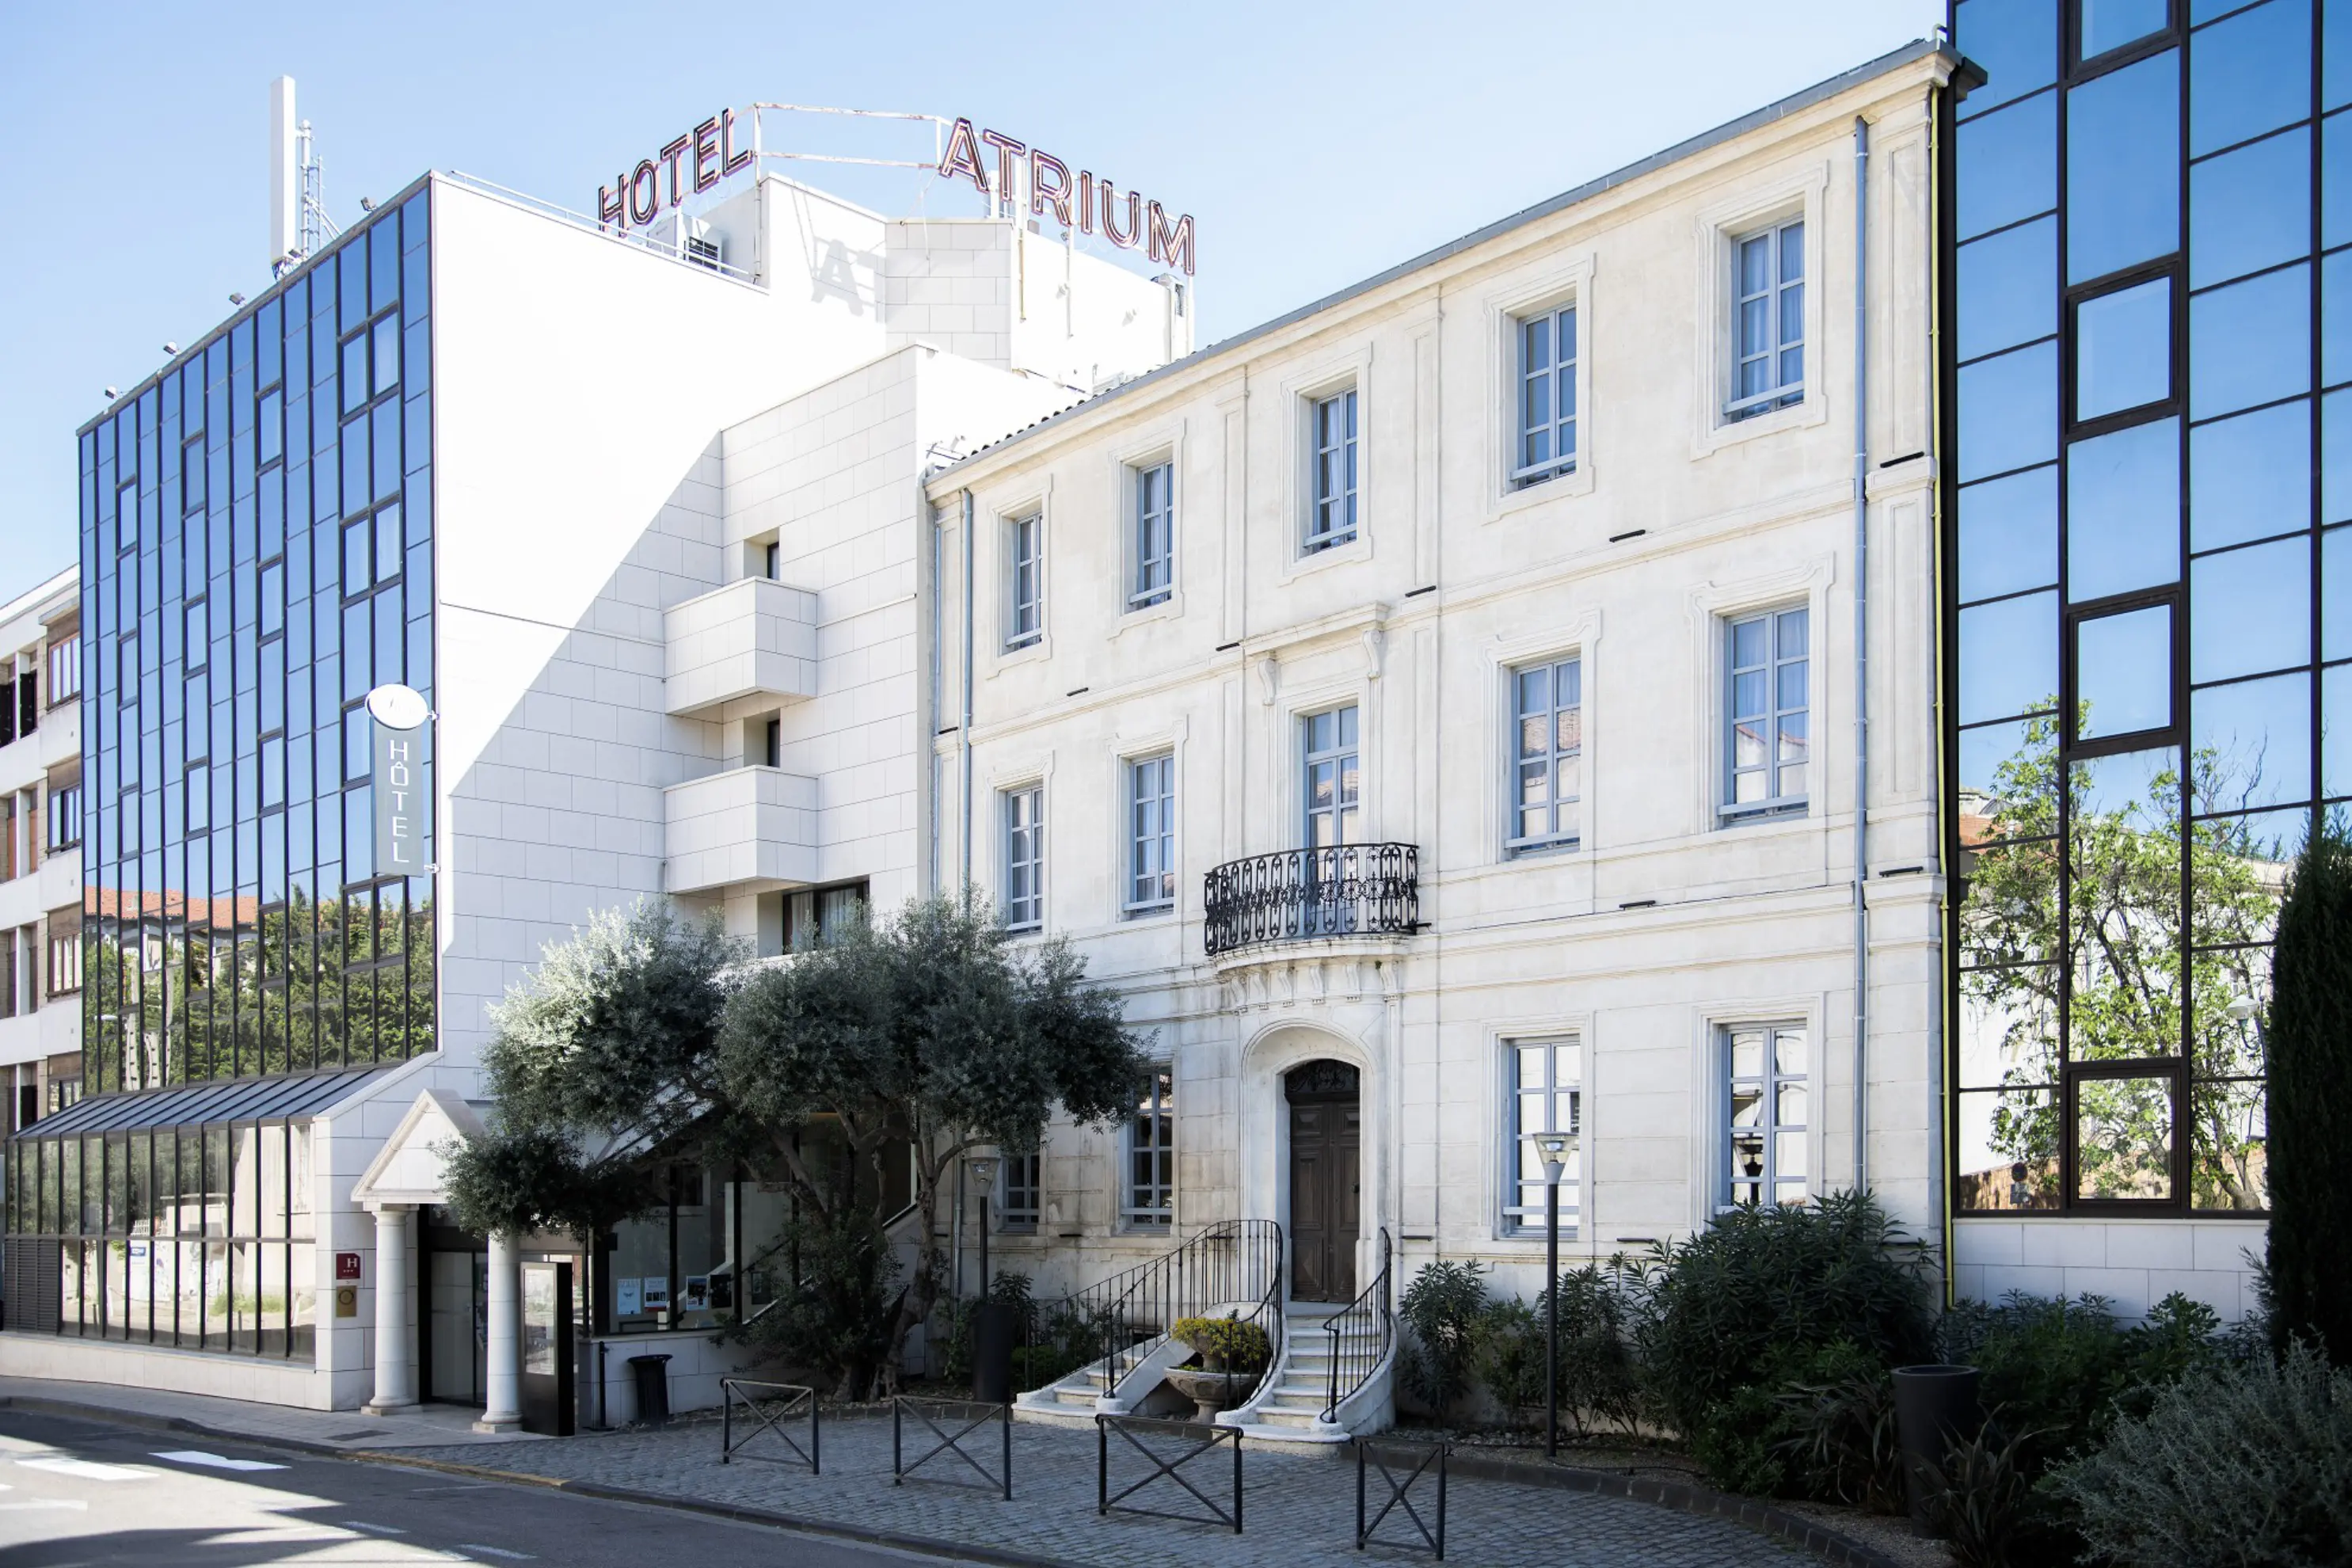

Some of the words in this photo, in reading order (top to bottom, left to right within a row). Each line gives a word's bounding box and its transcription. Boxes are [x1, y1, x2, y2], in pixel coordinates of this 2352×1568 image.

[599, 107, 753, 238] HOTEL
[939, 116, 1195, 276] ATRIUM
[390, 739, 409, 862] HÔTEL
[347, 1258, 358, 1268] H
